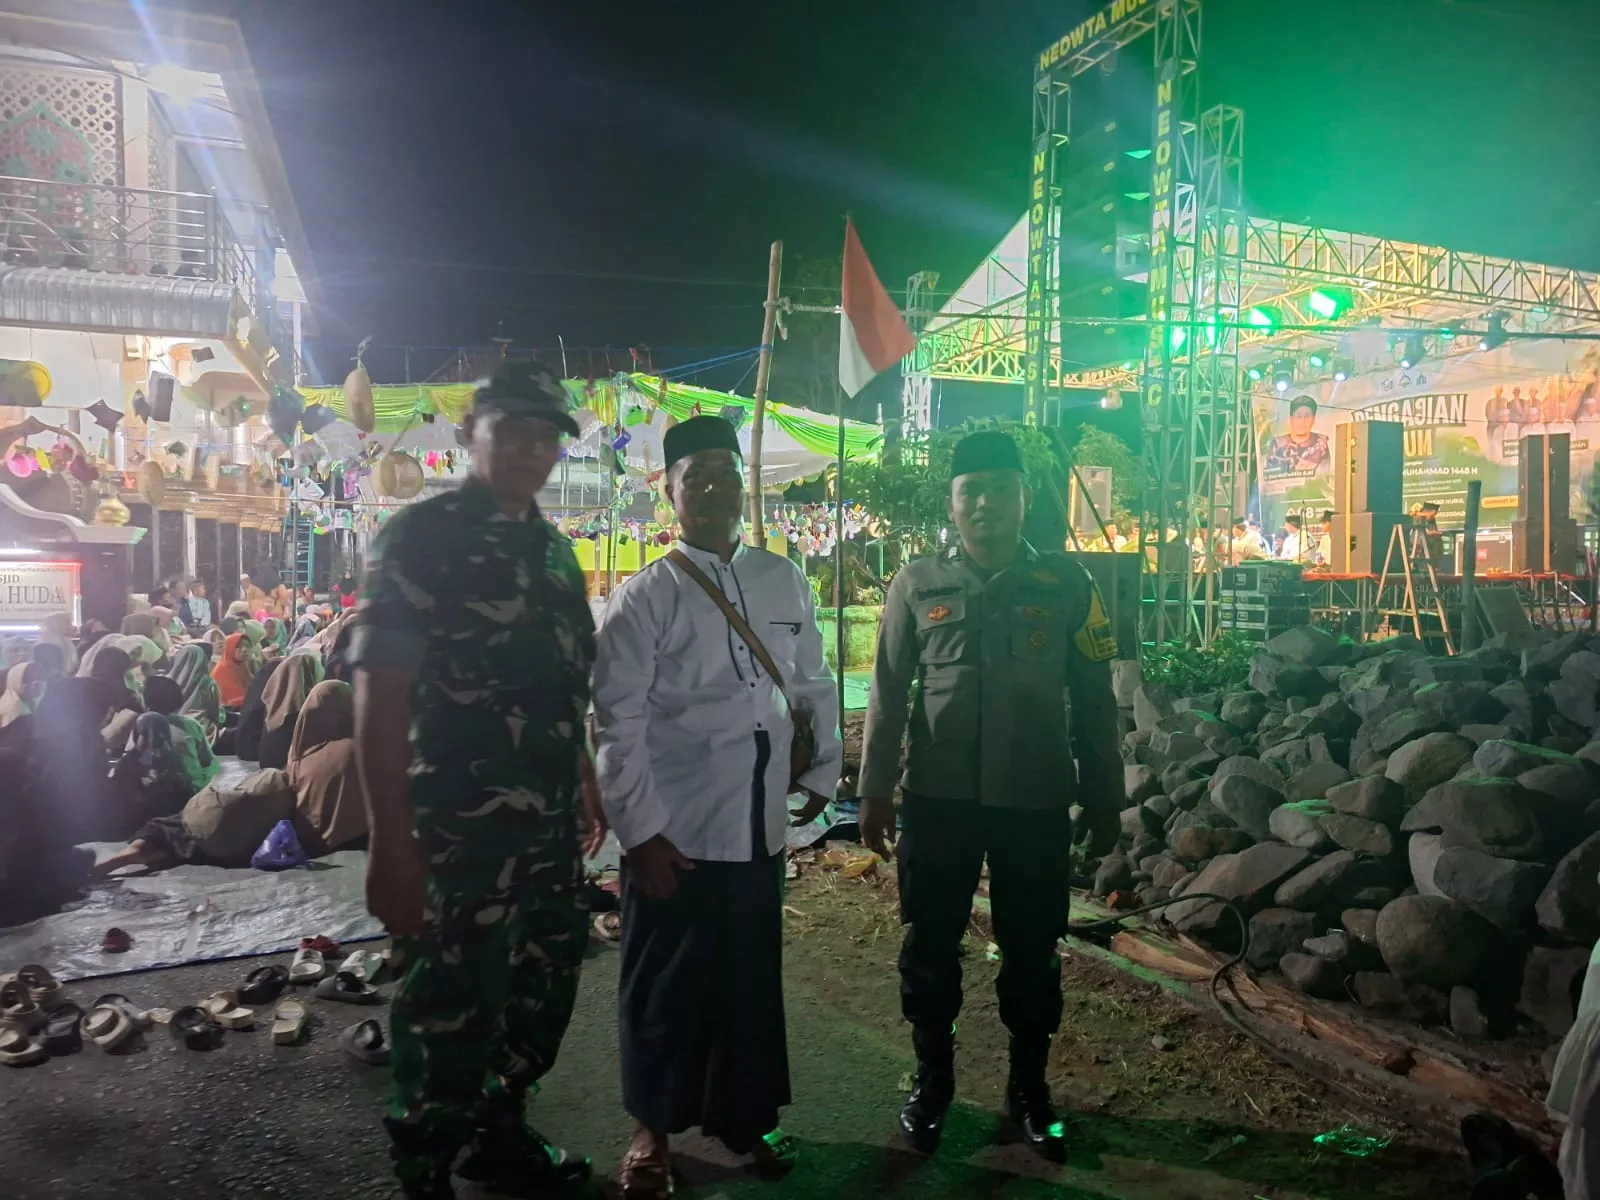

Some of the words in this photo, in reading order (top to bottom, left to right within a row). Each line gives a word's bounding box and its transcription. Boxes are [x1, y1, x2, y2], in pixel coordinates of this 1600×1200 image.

[1040, 11, 1107, 71] NEOWTA
[1028, 151, 1046, 301] NEOWTA
[1150, 79, 1173, 257] NEOWTA
[1024, 309, 1041, 429] MUSIC
[8, 585, 68, 604] HUDA
